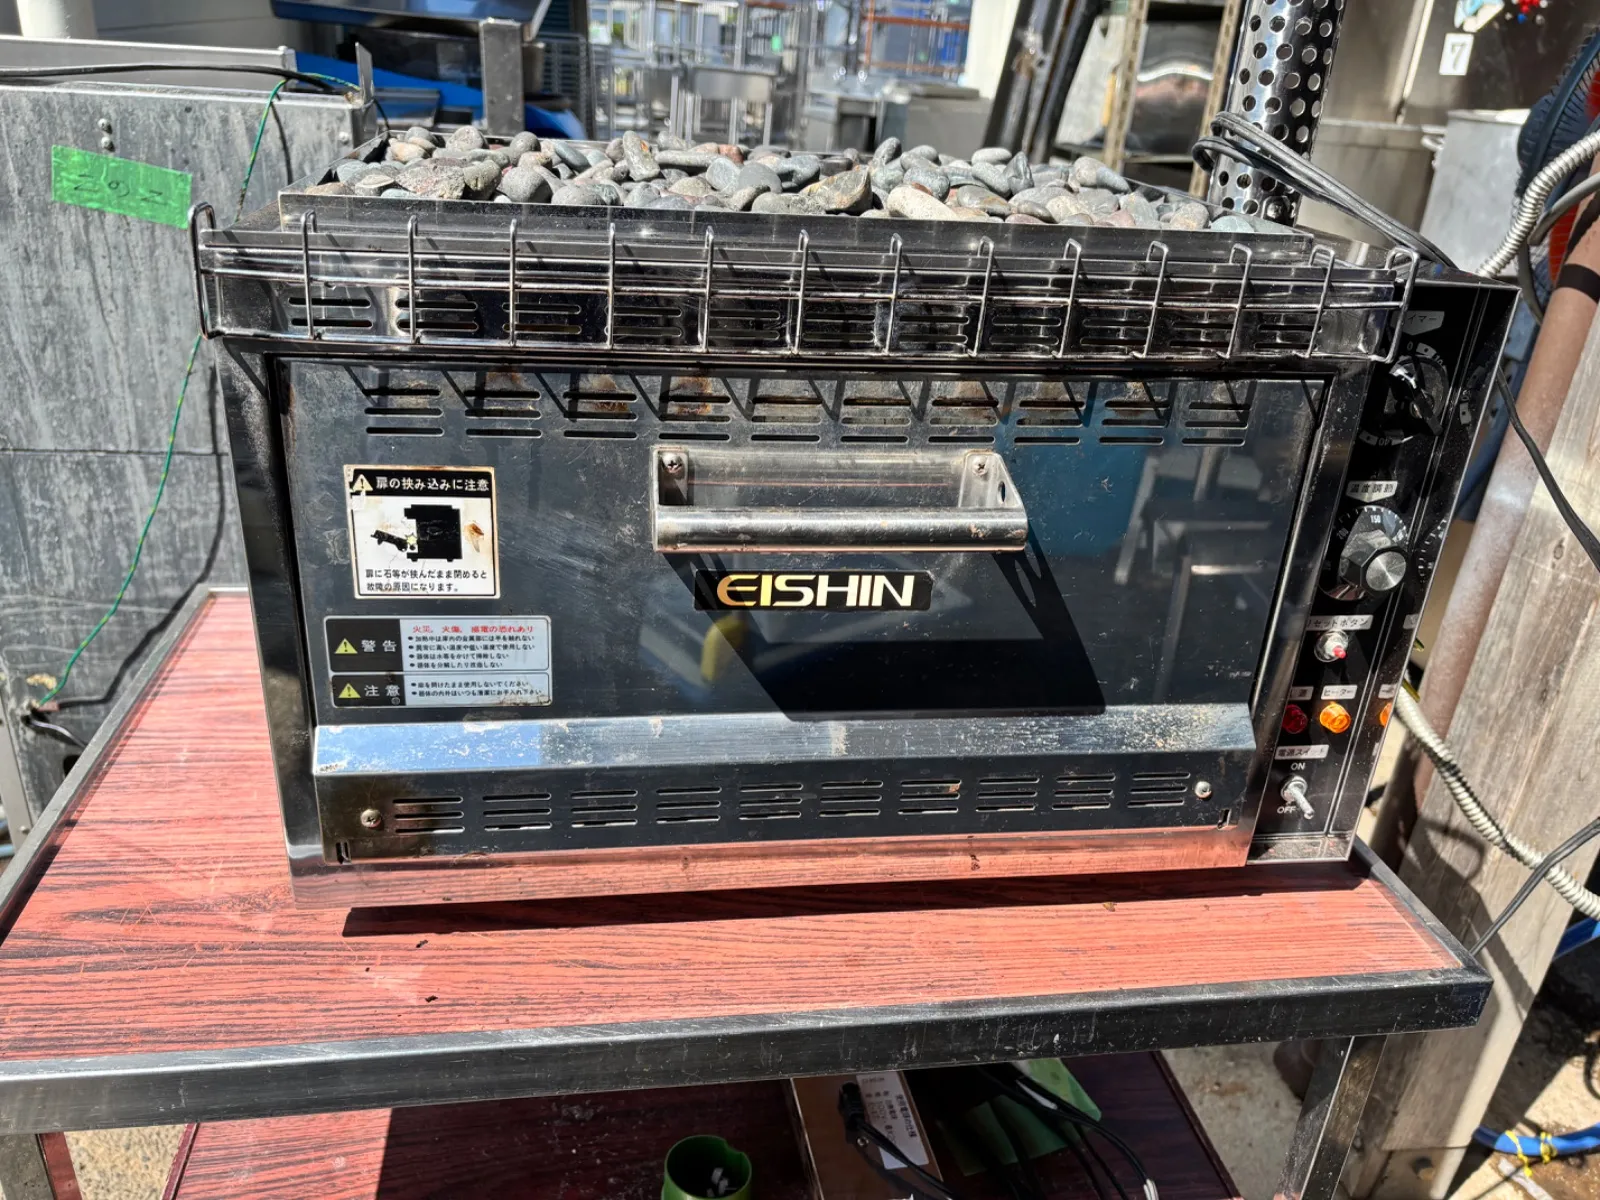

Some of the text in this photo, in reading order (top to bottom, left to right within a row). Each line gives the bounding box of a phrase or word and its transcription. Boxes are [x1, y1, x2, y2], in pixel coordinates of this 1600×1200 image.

[1451, 41, 1466, 71] 7
[375, 476, 490, 492] 扉の挟み込みに注意
[1370, 514, 1381, 524] 150
[365, 568, 487, 580] 扉に石等が挟んだまま閉めると
[366, 581, 459, 593] 故障の原因になります。
[716, 574, 915, 607] EISHIN
[361, 639, 398, 653] 警告
[364, 684, 401, 697] 注意
[1278, 747, 1325, 758] 電源スイ
[1290, 762, 1306, 771] ON
[1276, 806, 1297, 814] OFF
